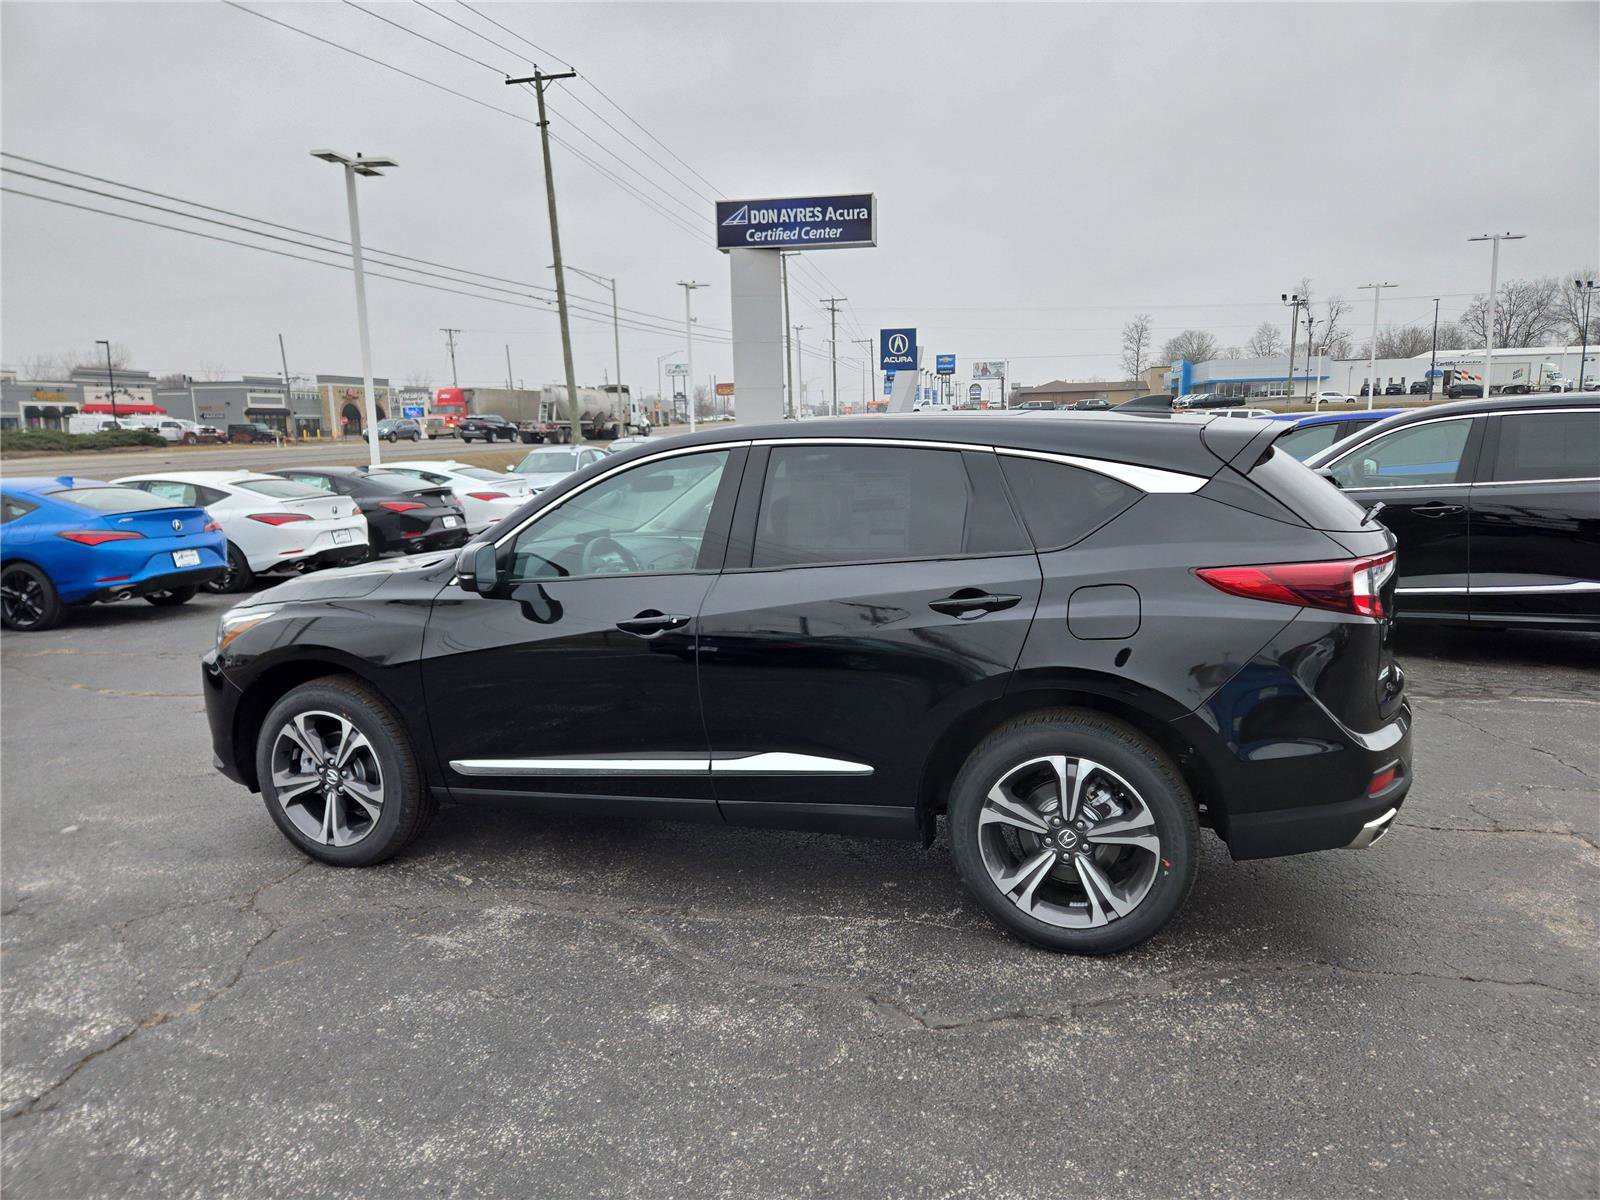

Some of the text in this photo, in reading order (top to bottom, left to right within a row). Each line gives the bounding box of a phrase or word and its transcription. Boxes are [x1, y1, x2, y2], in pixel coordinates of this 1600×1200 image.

[750, 206, 868, 224] DON AYRES Acura
[746, 226, 843, 242] Certified Center
